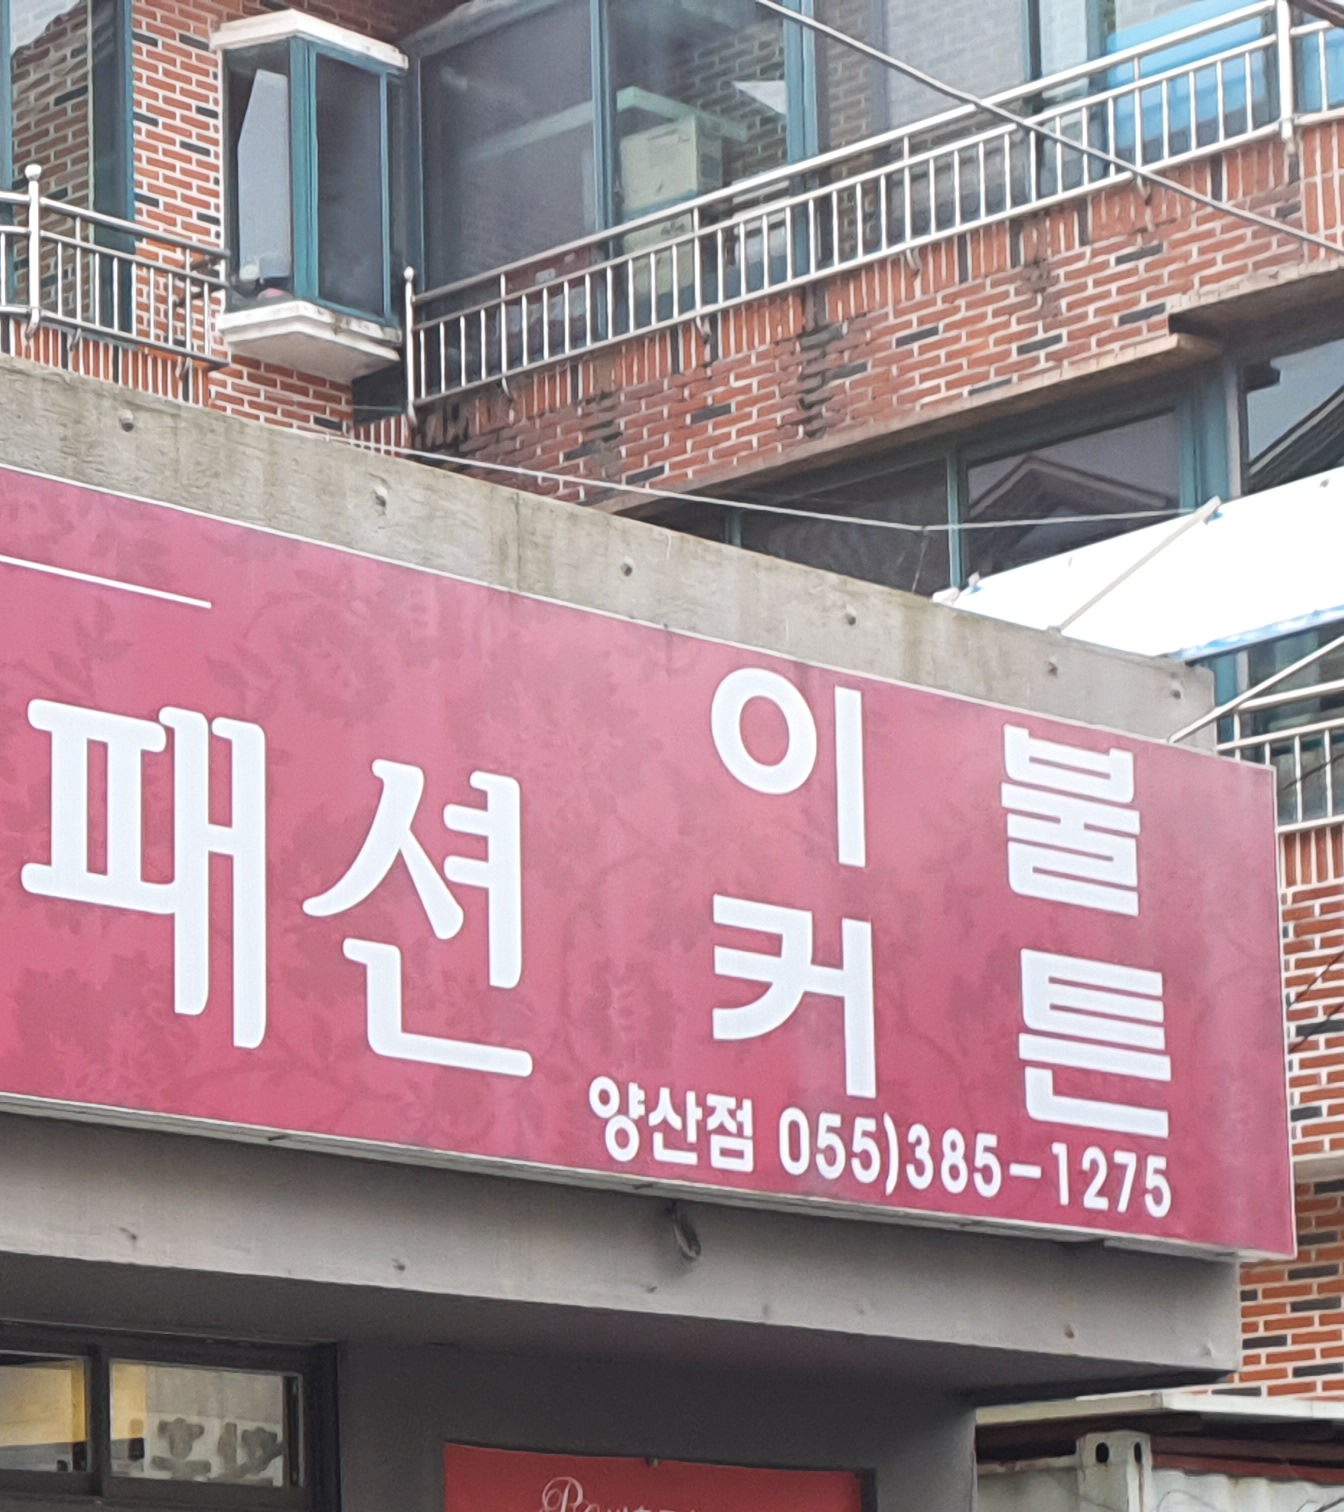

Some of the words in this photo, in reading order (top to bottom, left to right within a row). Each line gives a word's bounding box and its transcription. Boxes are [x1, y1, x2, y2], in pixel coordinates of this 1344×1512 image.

[710, 667, 1141, 917] 이불
[712, 893, 1172, 1139] 커튼
[588, 1075, 756, 1173] 양산점
[778, 1107, 1172, 1218] 055)385-1275
